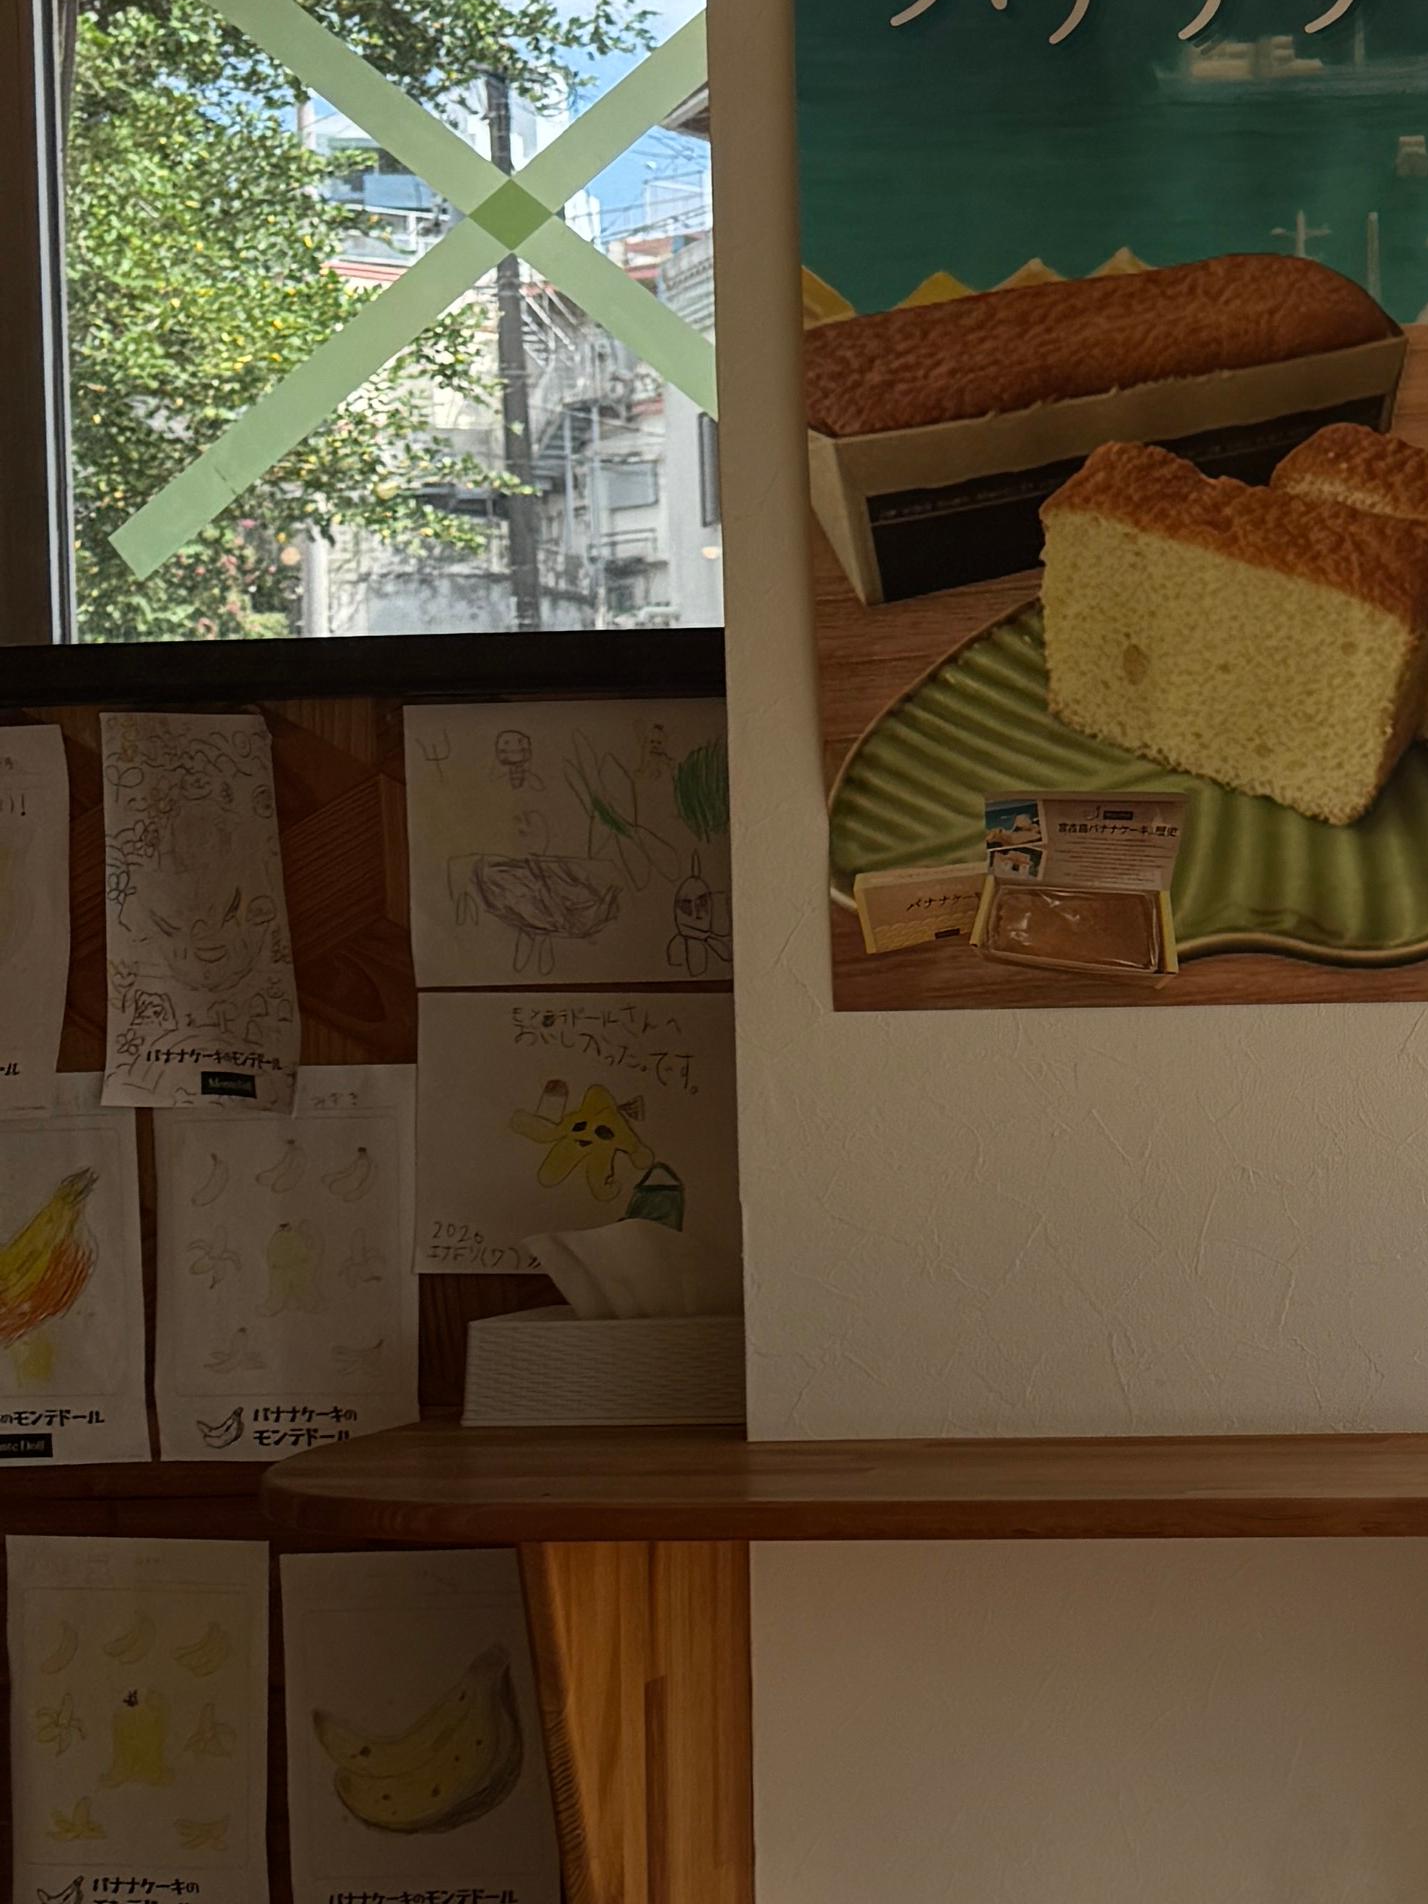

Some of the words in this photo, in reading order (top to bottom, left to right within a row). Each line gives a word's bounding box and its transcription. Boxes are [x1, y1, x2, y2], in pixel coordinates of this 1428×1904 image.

[253, 1405, 358, 1423] バナナケーキの
[92, 1876, 200, 1895] バナナケーキの
